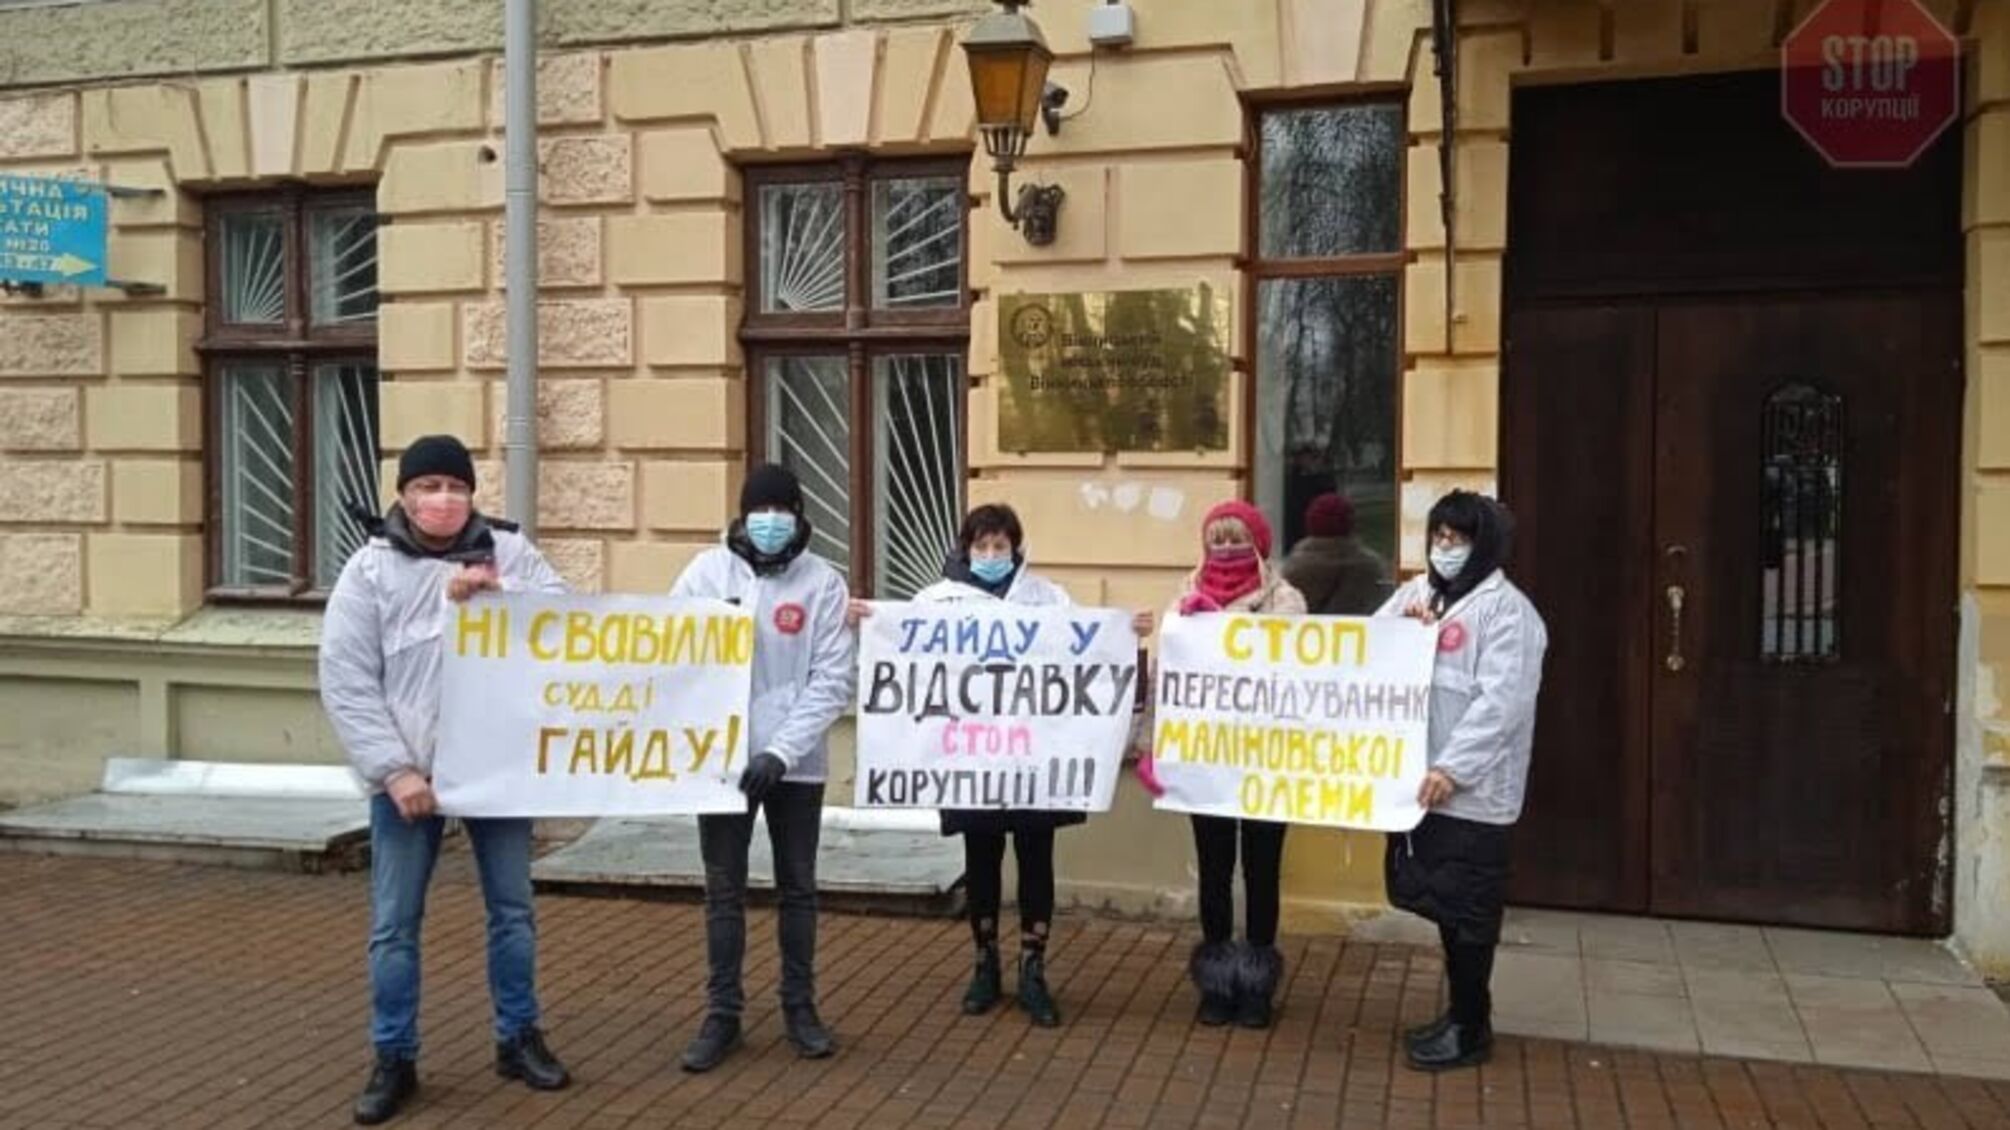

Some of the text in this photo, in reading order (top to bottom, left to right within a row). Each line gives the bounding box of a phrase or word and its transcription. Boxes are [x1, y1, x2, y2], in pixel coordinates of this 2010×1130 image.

[456, 605, 509, 659] НІ
[900, 614, 1101, 663] ГАЙДУ У
[1223, 617, 1369, 666] СТОП
[864, 661, 1136, 723] ВІДСТАВКУ
[537, 714, 741, 784] ГАЙДУ!
[941, 723, 1032, 758] СТОП
[1241, 774, 1375, 823] ОЛЕНИ
